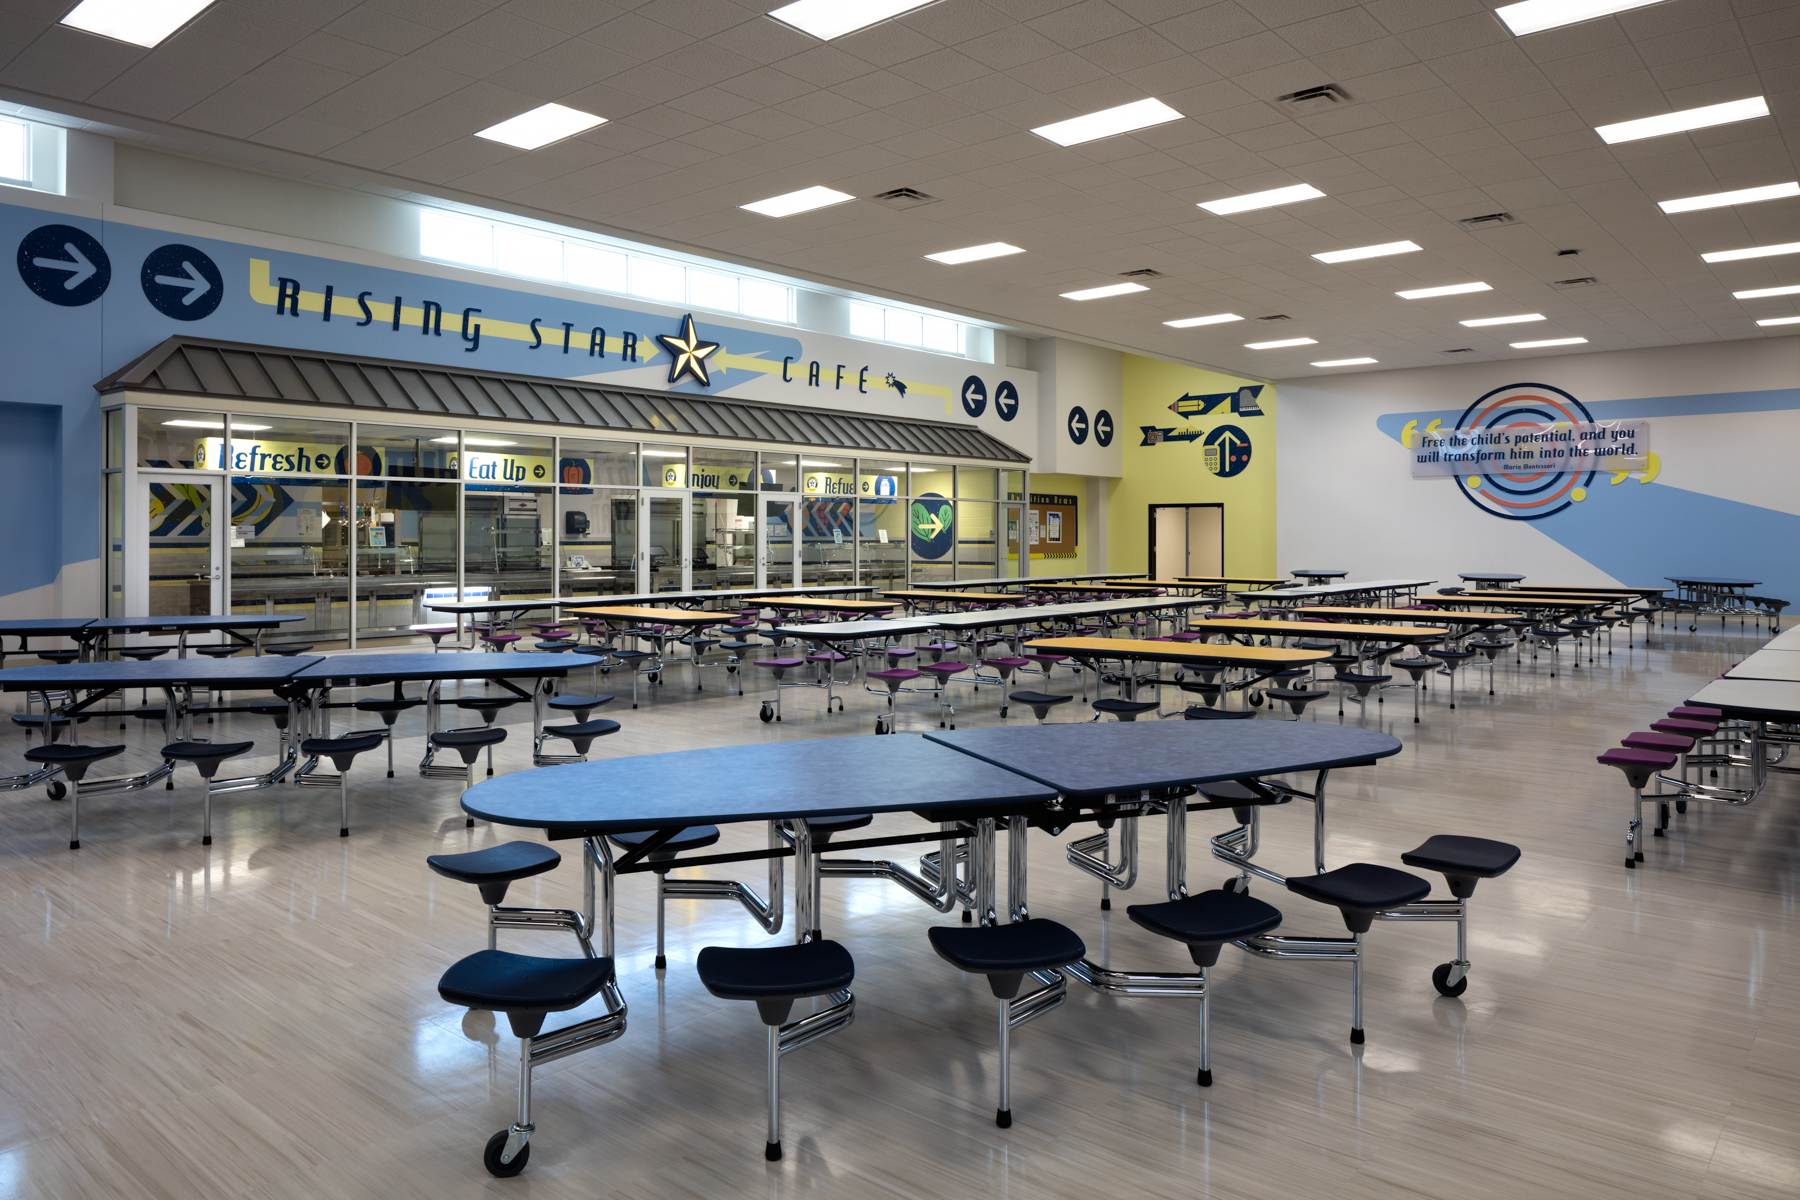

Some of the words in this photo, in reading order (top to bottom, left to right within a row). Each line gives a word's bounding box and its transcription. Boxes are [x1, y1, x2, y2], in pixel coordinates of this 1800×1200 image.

[276, 276, 482, 352] RISING
[528, 317, 638, 363] STAR
[782, 355, 869, 394] CAFÉ
[1422, 436, 1446, 448] Free
[1449, 434, 1467, 447] the
[1471, 432, 1511, 447] child's
[1580, 428, 1605, 441] and
[1611, 429, 1635, 442] you
[1417, 450, 1439, 463] will
[1444, 450, 1505, 464] transform
[1510, 447, 1534, 460] him
[1540, 447, 1565, 459] into
[1569, 445, 1589, 457] the
[1594, 443, 1638, 456] world.
[469, 456, 497, 480] Eat
[503, 458, 526, 481] Up
[692, 468, 720, 489] njoy
[825, 476, 856, 495] Refue
